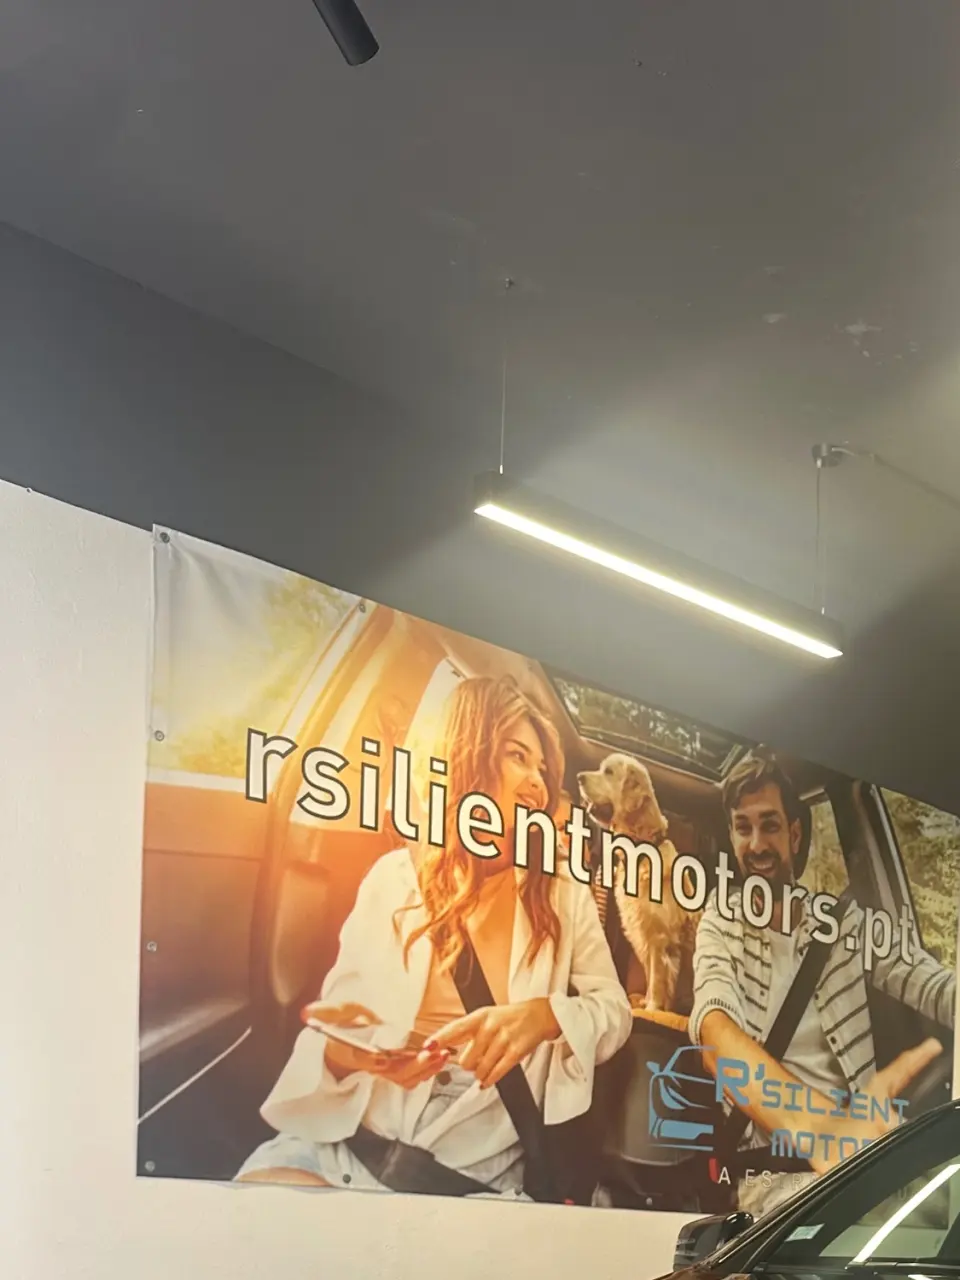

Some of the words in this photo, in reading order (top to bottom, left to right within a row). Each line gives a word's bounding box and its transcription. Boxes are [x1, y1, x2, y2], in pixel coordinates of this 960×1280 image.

[245, 727, 915, 973] rsilientmotors.pt
[715, 1057, 910, 1124] R'SILIENT
[718, 1166, 732, 1185] A
[745, 1168, 819, 1191] ESTR
